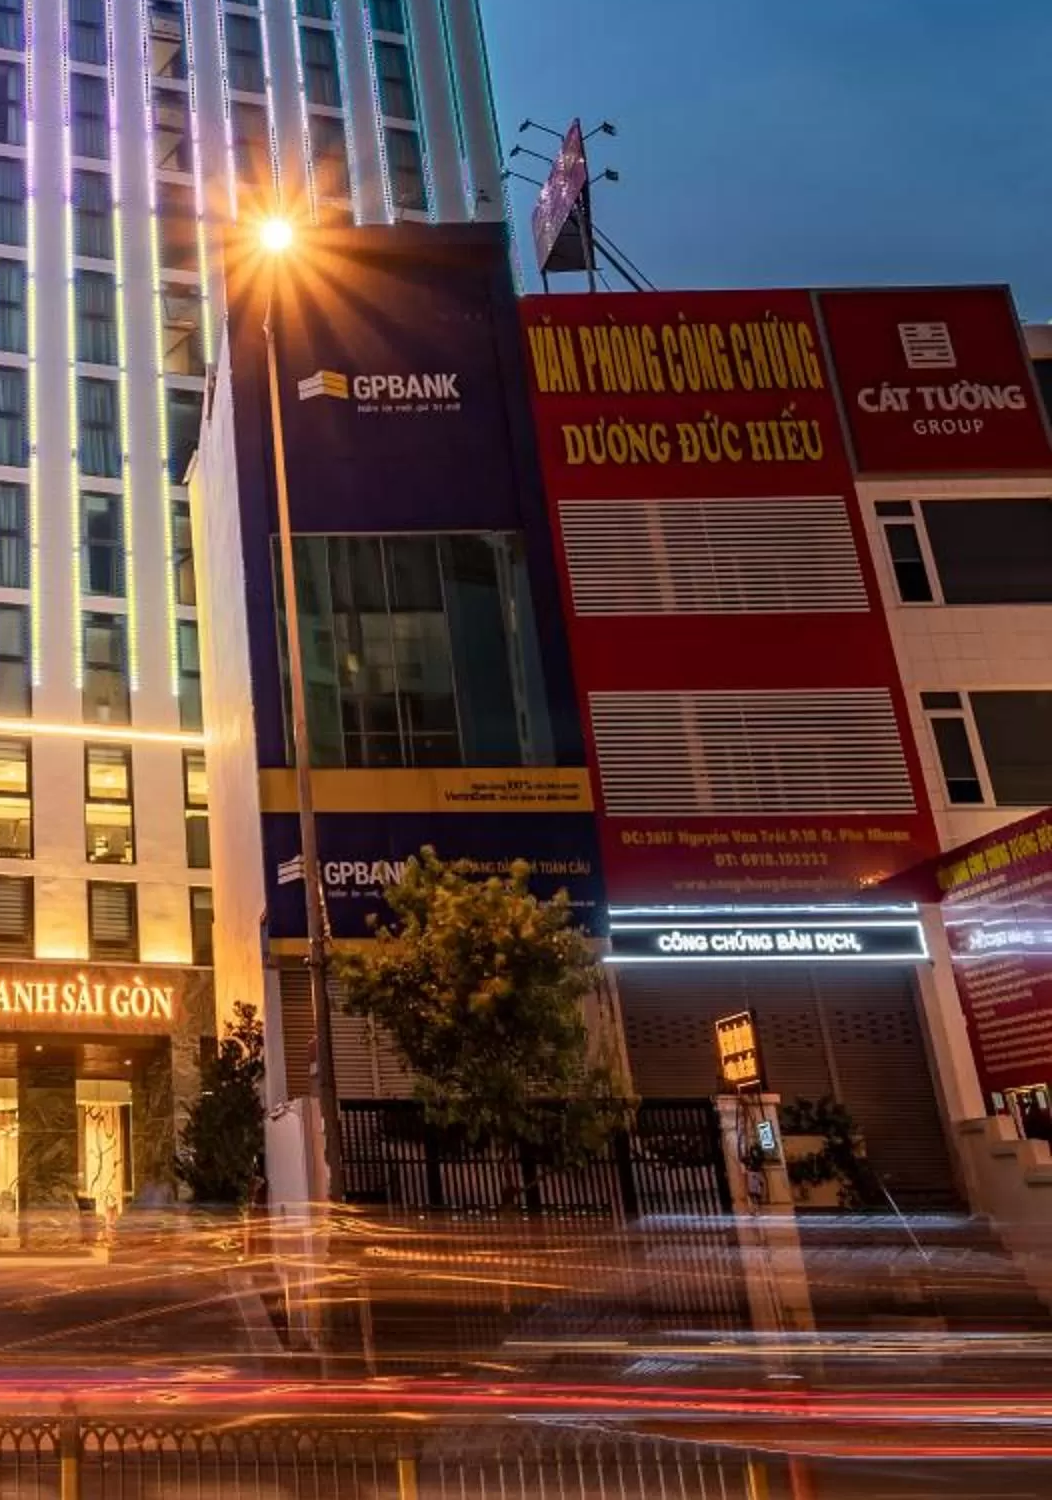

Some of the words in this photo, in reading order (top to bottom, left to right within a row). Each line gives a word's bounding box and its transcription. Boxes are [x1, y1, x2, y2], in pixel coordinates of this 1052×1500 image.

[527, 312, 581, 393] VĂN
[577, 312, 666, 394] PHÒNG
[660, 310, 735, 394] CÔNG
[728, 309, 825, 392] CHỨNG
[353, 372, 461, 400] GPBANK
[857, 381, 912, 413] CÁT
[915, 379, 1027, 412] TƯỜNG
[561, 415, 671, 465] DƯƠNG
[675, 409, 743, 464] ĐỨC
[745, 401, 824, 462] HIẾU
[912, 418, 984, 435] GROUP
[323, 861, 406, 885] GPBAN
[658, 930, 708, 951] CÔNG
[710, 929, 773, 951] CHỨNG
[60, 973, 108, 1016] SÀI
[110, 976, 174, 1020] GÒN
